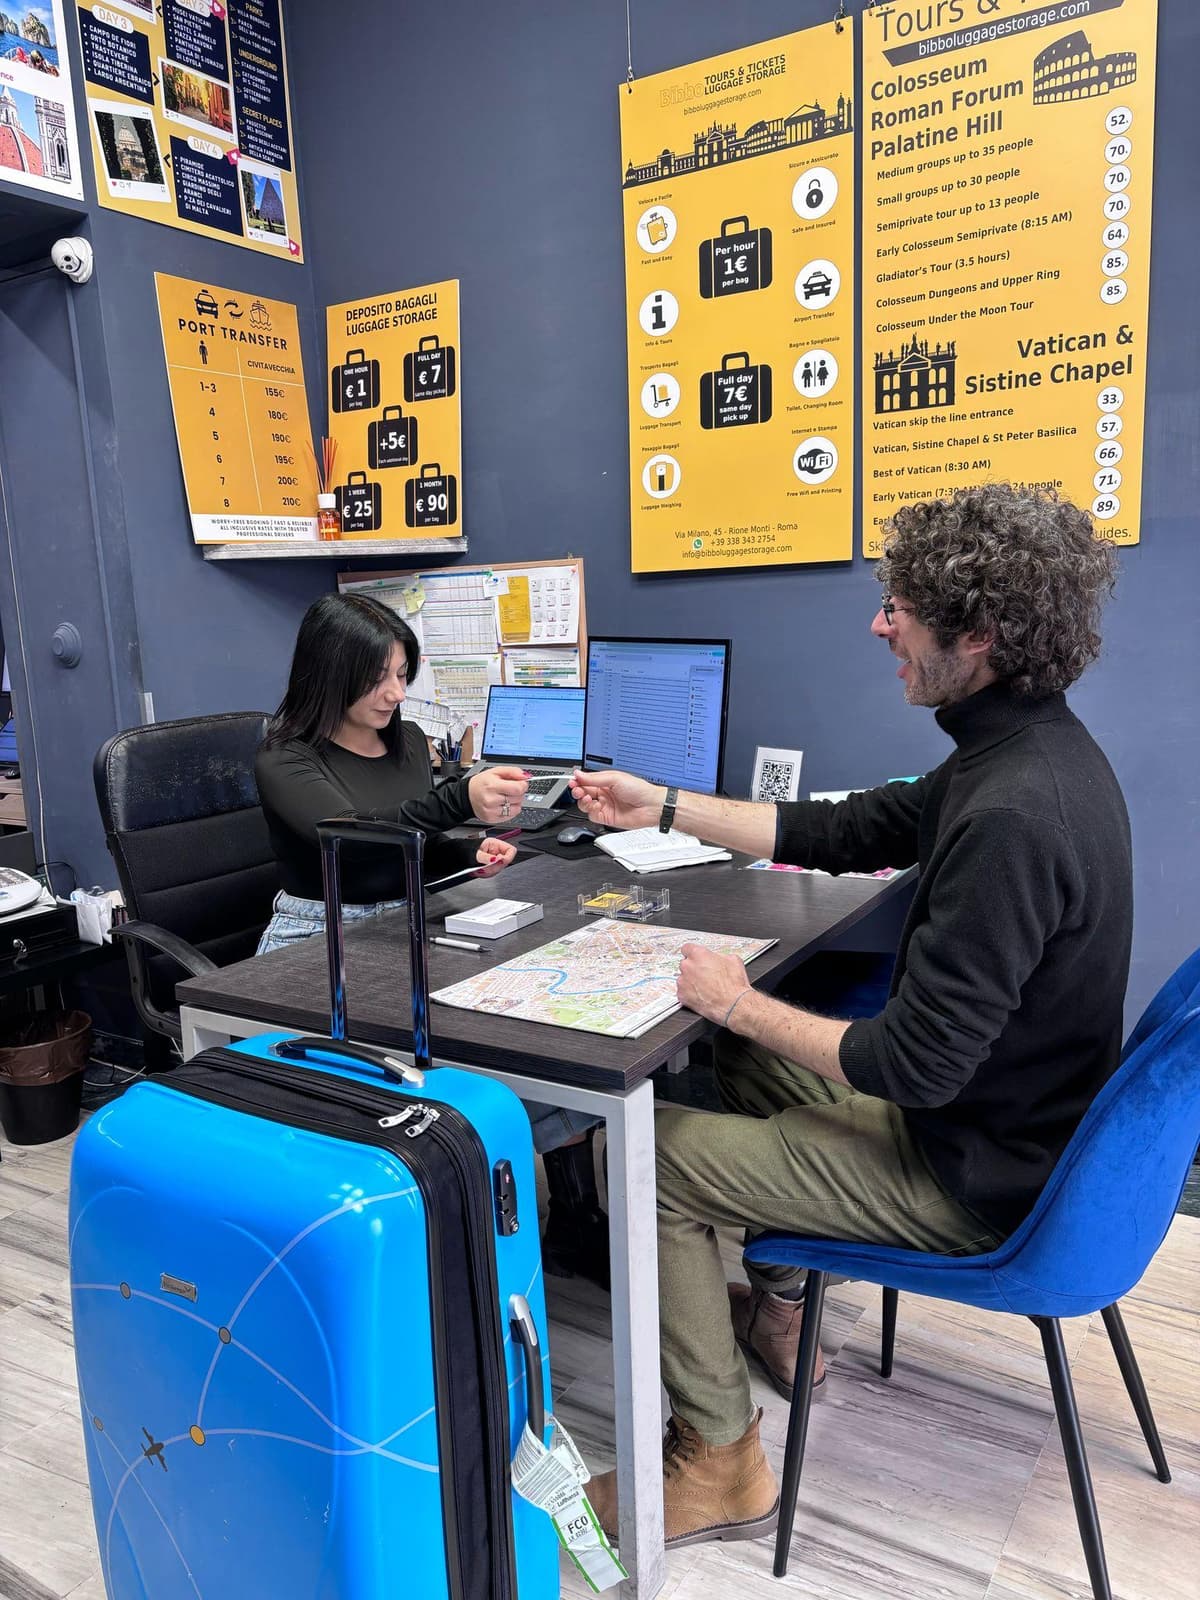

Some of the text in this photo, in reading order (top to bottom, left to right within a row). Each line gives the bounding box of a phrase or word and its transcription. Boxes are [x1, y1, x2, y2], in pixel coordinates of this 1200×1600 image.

[99, 7, 127, 29] DAY 3
[876, 0, 964, 42] Tours
[919, 1, 1090, 56] bibboluggagestorage.com
[705, 54, 786, 85] TOURS & TICKETS
[705, 64, 786, 95] LUGGAGE STORAGE
[871, 58, 987, 101] Colosseum
[659, 82, 704, 107] Bibbo
[683, 88, 761, 116] bibboluggagestorage.com
[871, 79, 1023, 131] Roman Forum
[871, 110, 1002, 160] Palatine Hill
[877, 137, 1033, 180] Medium groups up to 35 people
[877, 190, 1040, 232] Semiprivate tour up to 13 people
[816, 220, 835, 229] Insured
[877, 211, 1072, 258] Early Colosseum Semiprivate (8:15 AM)
[715, 241, 755, 256] Per hour
[724, 256, 747, 275] 1€
[876, 250, 1010, 283] Gladiator's Tour (3.5 hours)
[722, 276, 749, 288] per bag
[876, 268, 1060, 308] Colosseum Dungeons and Upper Ring
[346, 292, 437, 322] DEPOSITO BAGAGLI
[876, 300, 1034, 333] Colosseum Under the Moon Tour
[346, 308, 437, 336] LUGGAGE STORAGE
[794, 311, 835, 323] Airport Transfer
[178, 318, 288, 350] PORT TRANSFER
[1017, 325, 1133, 358] Vatican &
[418, 352, 440, 362] FULL DAY
[247, 360, 295, 374] CIVITAVECCHIA
[355, 366, 368, 374] HOUR
[419, 364, 441, 385] € 7
[965, 355, 1132, 394] Sistine Chapel
[346, 379, 366, 398] € 1
[718, 374, 753, 385] Full day
[200, 381, 285, 398] 1-3 155€
[724, 386, 747, 403] 7€
[209, 407, 288, 421] 4 180€
[739, 413, 748, 421] up
[873, 408, 1014, 430] Vatican skip the line entrance
[213, 431, 291, 443] 5 190€
[380, 432, 406, 450] +5€
[873, 426, 1077, 453] Vatican, Sistine Chapel & St Peter Basilica
[216, 454, 294, 465] 6 195€
[873, 460, 991, 477] Best of Vatican (8:30 AM)
[220, 476, 298, 486] 7 200€
[224, 497, 301, 507] 8 210€
[343, 505, 350, 518] €
[354, 500, 372, 517] 25
[416, 494, 447, 512] € 90
[688, 529, 712, 538] Milano,
[713, 528, 722, 536] 45
[729, 527, 748, 535] Rione
[751, 524, 770, 533] Monti
[778, 523, 798, 531] Roma
[711, 535, 775, 546] +39 338 343 2754
[682, 544, 792, 559] info@bibboluggagestorage.com
